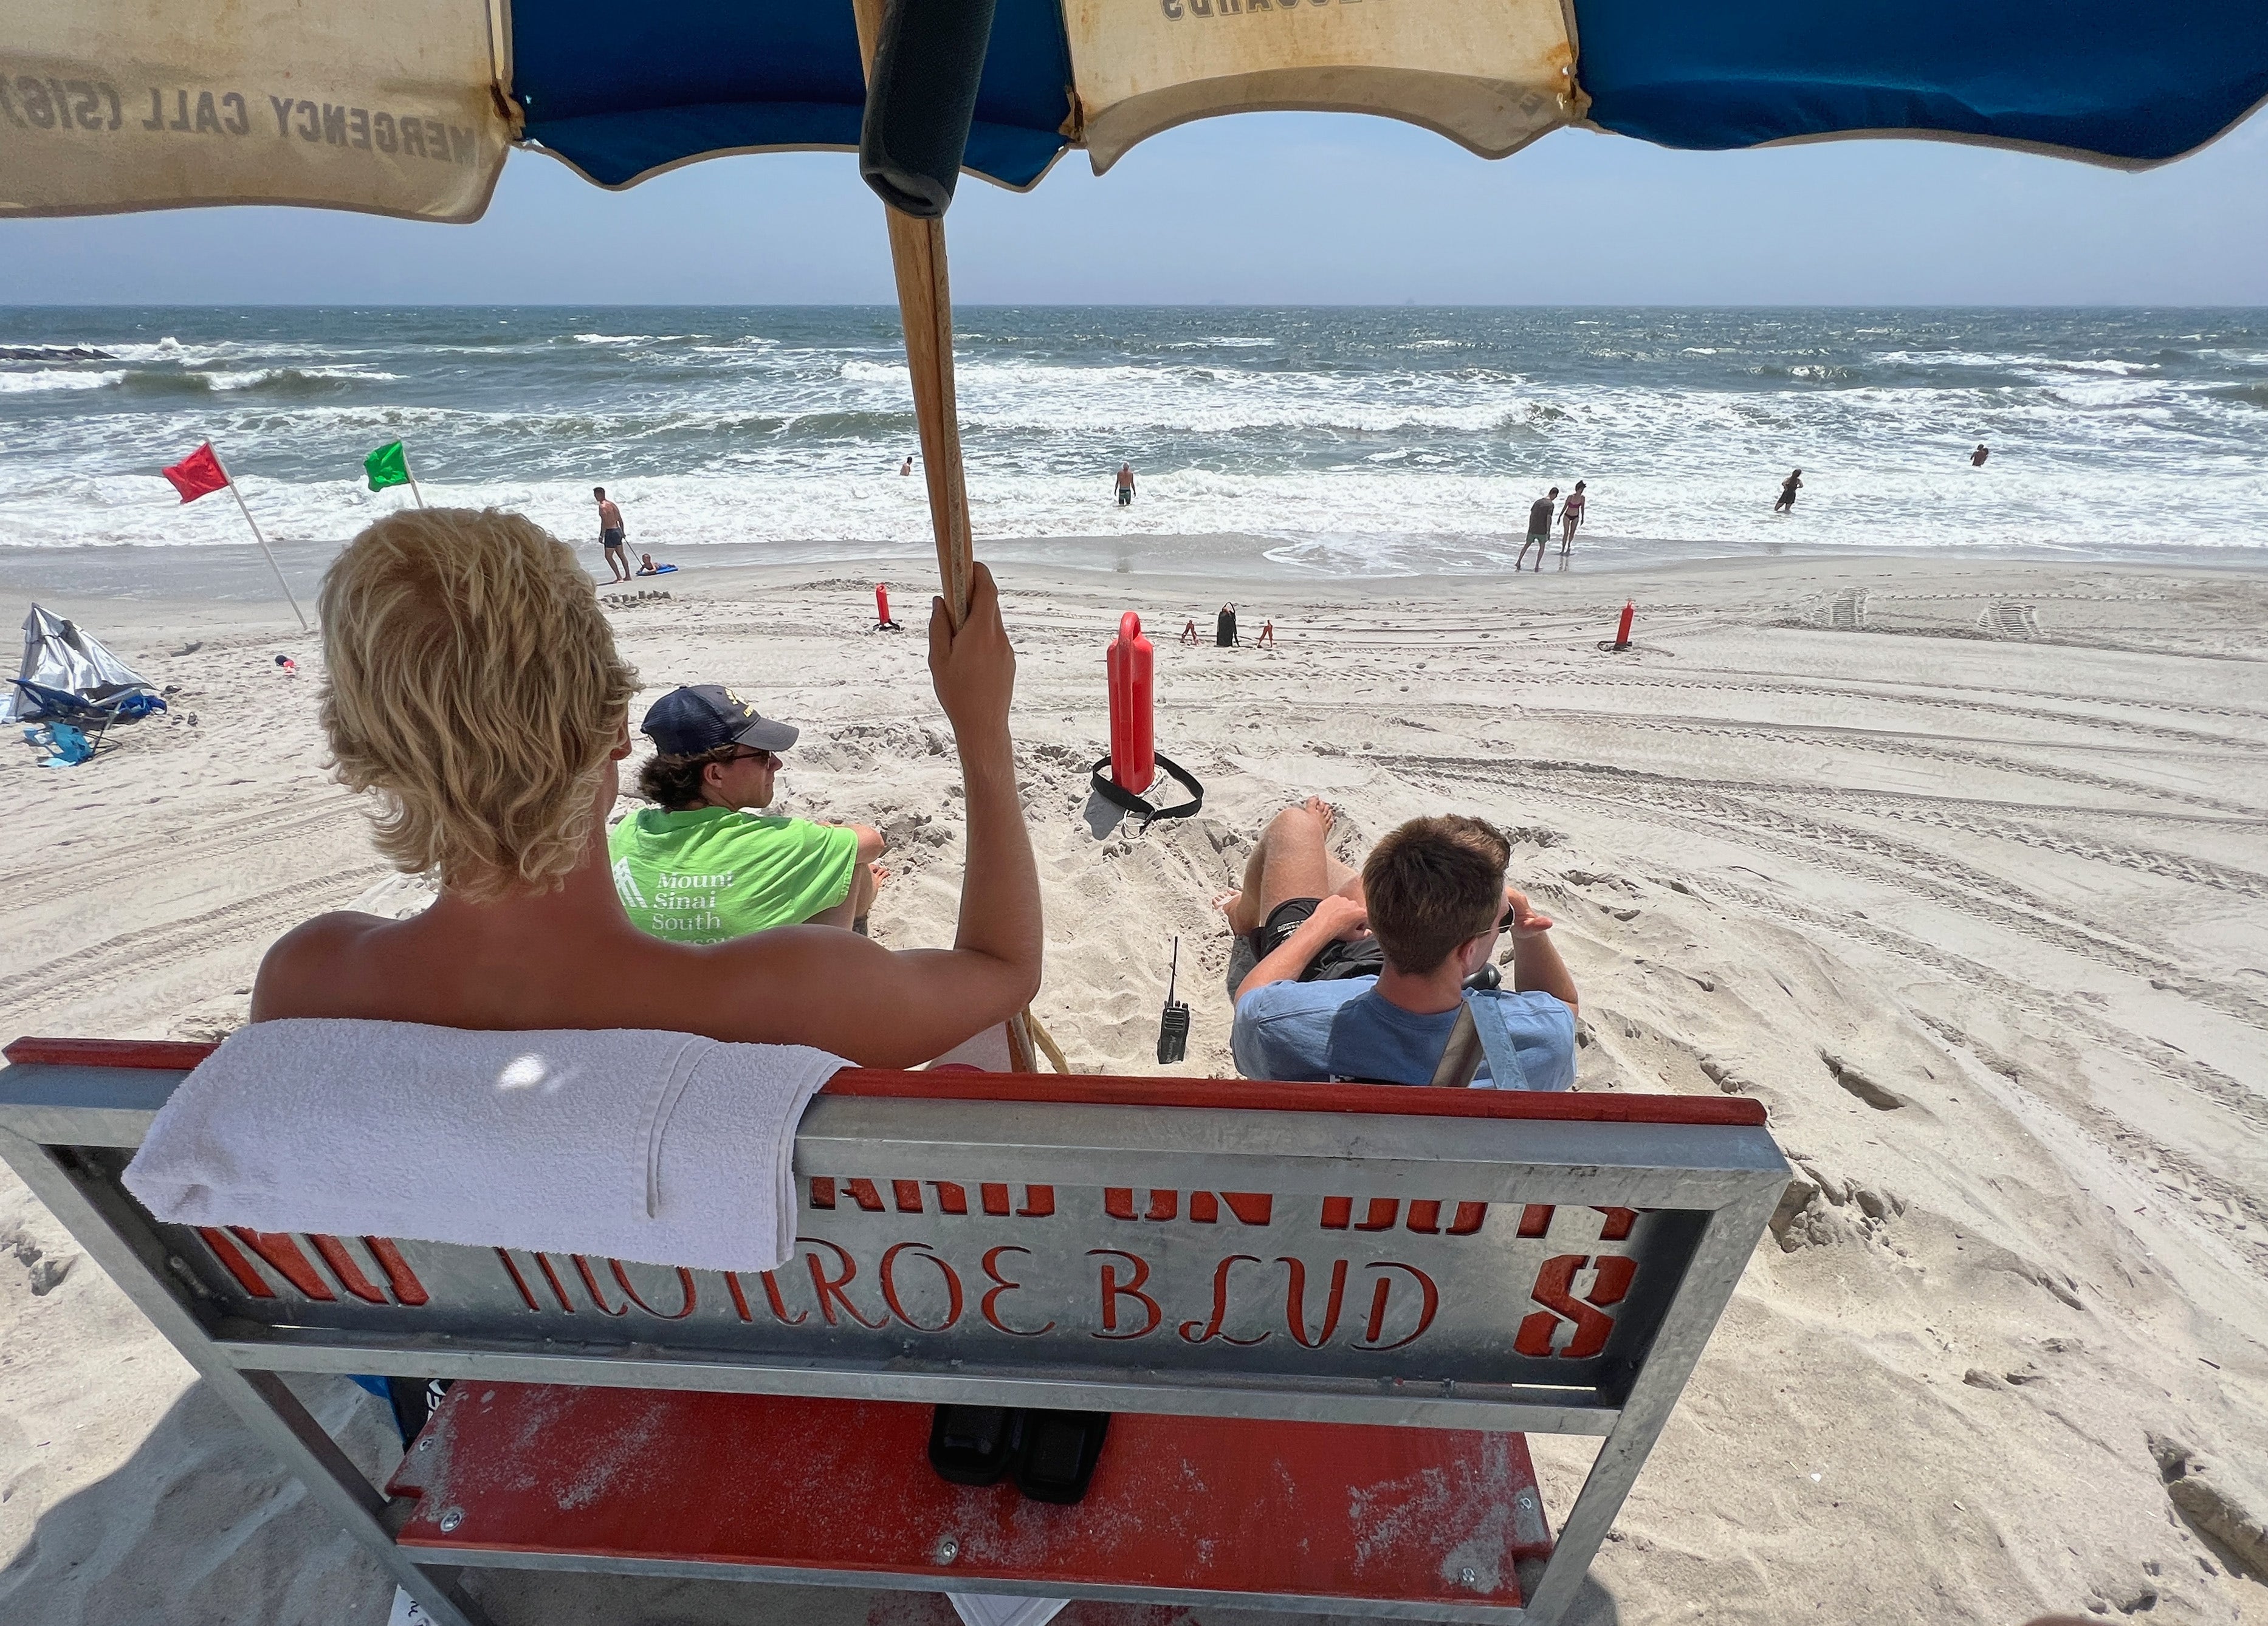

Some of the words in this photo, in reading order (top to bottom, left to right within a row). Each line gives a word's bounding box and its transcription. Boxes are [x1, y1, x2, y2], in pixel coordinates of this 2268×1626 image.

[656, 871, 735, 888] Mount
[653, 890, 716, 910] Sinai
[651, 911, 721, 931] South
[1085, 1248, 1439, 1353] BLVD
